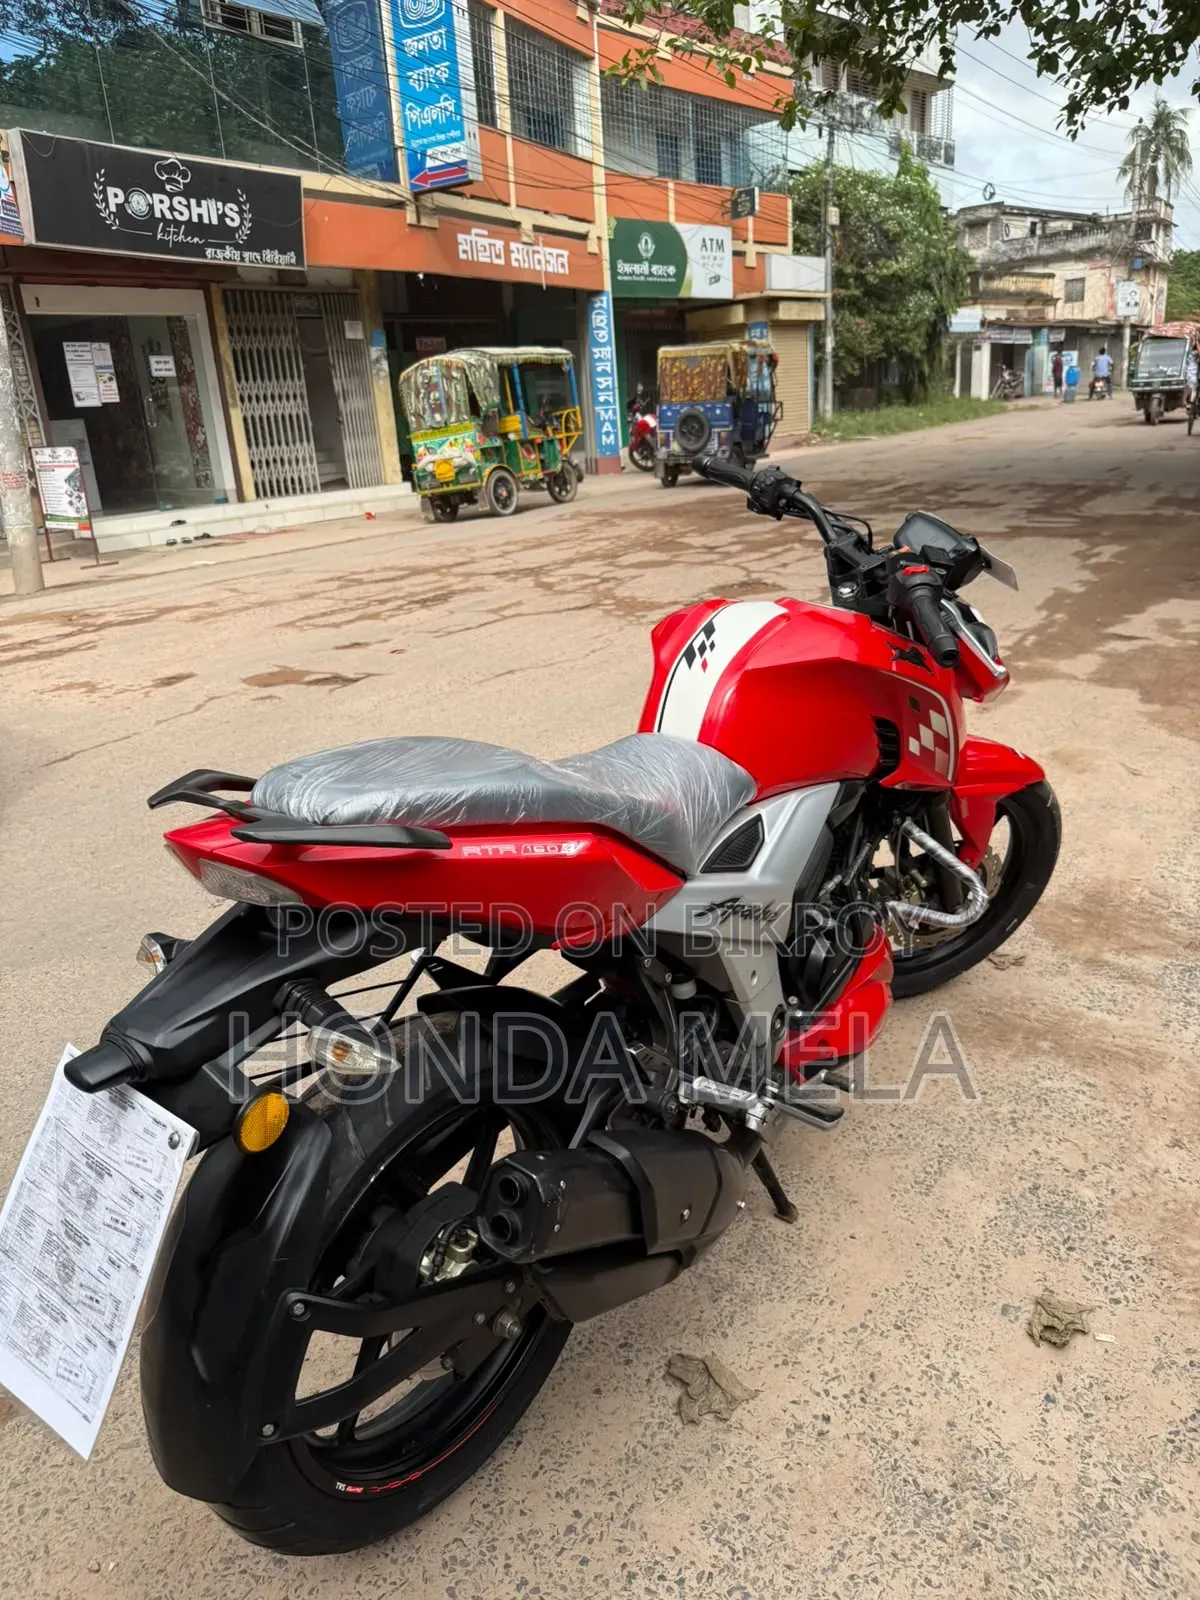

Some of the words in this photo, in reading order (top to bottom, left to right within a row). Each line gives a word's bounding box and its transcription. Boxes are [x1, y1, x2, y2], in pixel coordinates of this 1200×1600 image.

[402, 26, 447, 57] জনতা
[406, 61, 450, 92] ব্যাংক
[106, 186, 241, 228] PORSHI'S
[156, 222, 206, 248] kitchen
[700, 237, 725, 253] ATM
[462, 844, 517, 857] RTR
